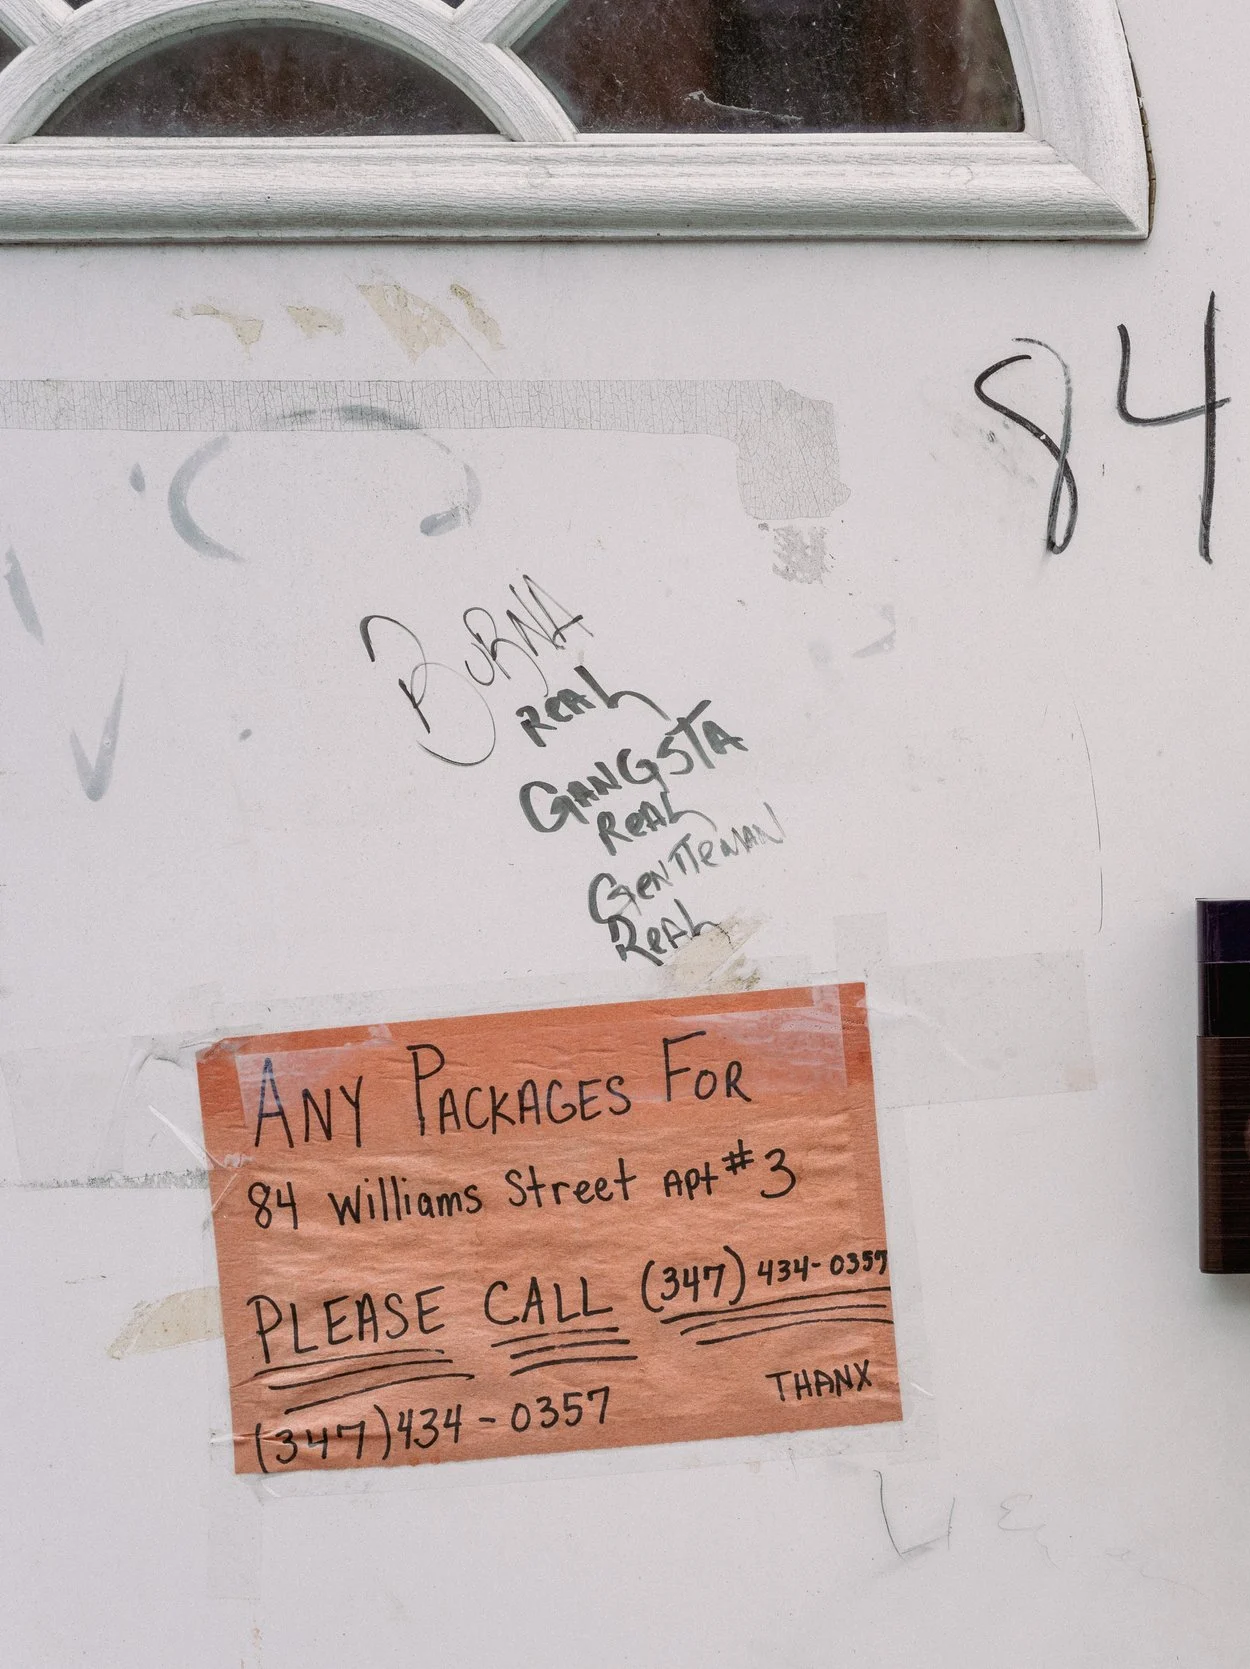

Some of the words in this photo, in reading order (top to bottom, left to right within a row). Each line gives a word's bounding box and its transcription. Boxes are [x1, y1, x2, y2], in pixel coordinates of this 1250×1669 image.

[974, 290, 1231, 564] 84
[519, 700, 749, 832] GANGSTA
[254, 1058, 364, 1148] ANY
[407, 1043, 632, 1136] PACKAGES
[662, 1031, 752, 1102] FOR
[247, 1181, 298, 1230] 84
[504, 1157, 637, 1208] Street
[247, 1286, 446, 1364] PLEASE
[484, 1276, 613, 1326] CALL
[765, 1359, 873, 1402] THANX
